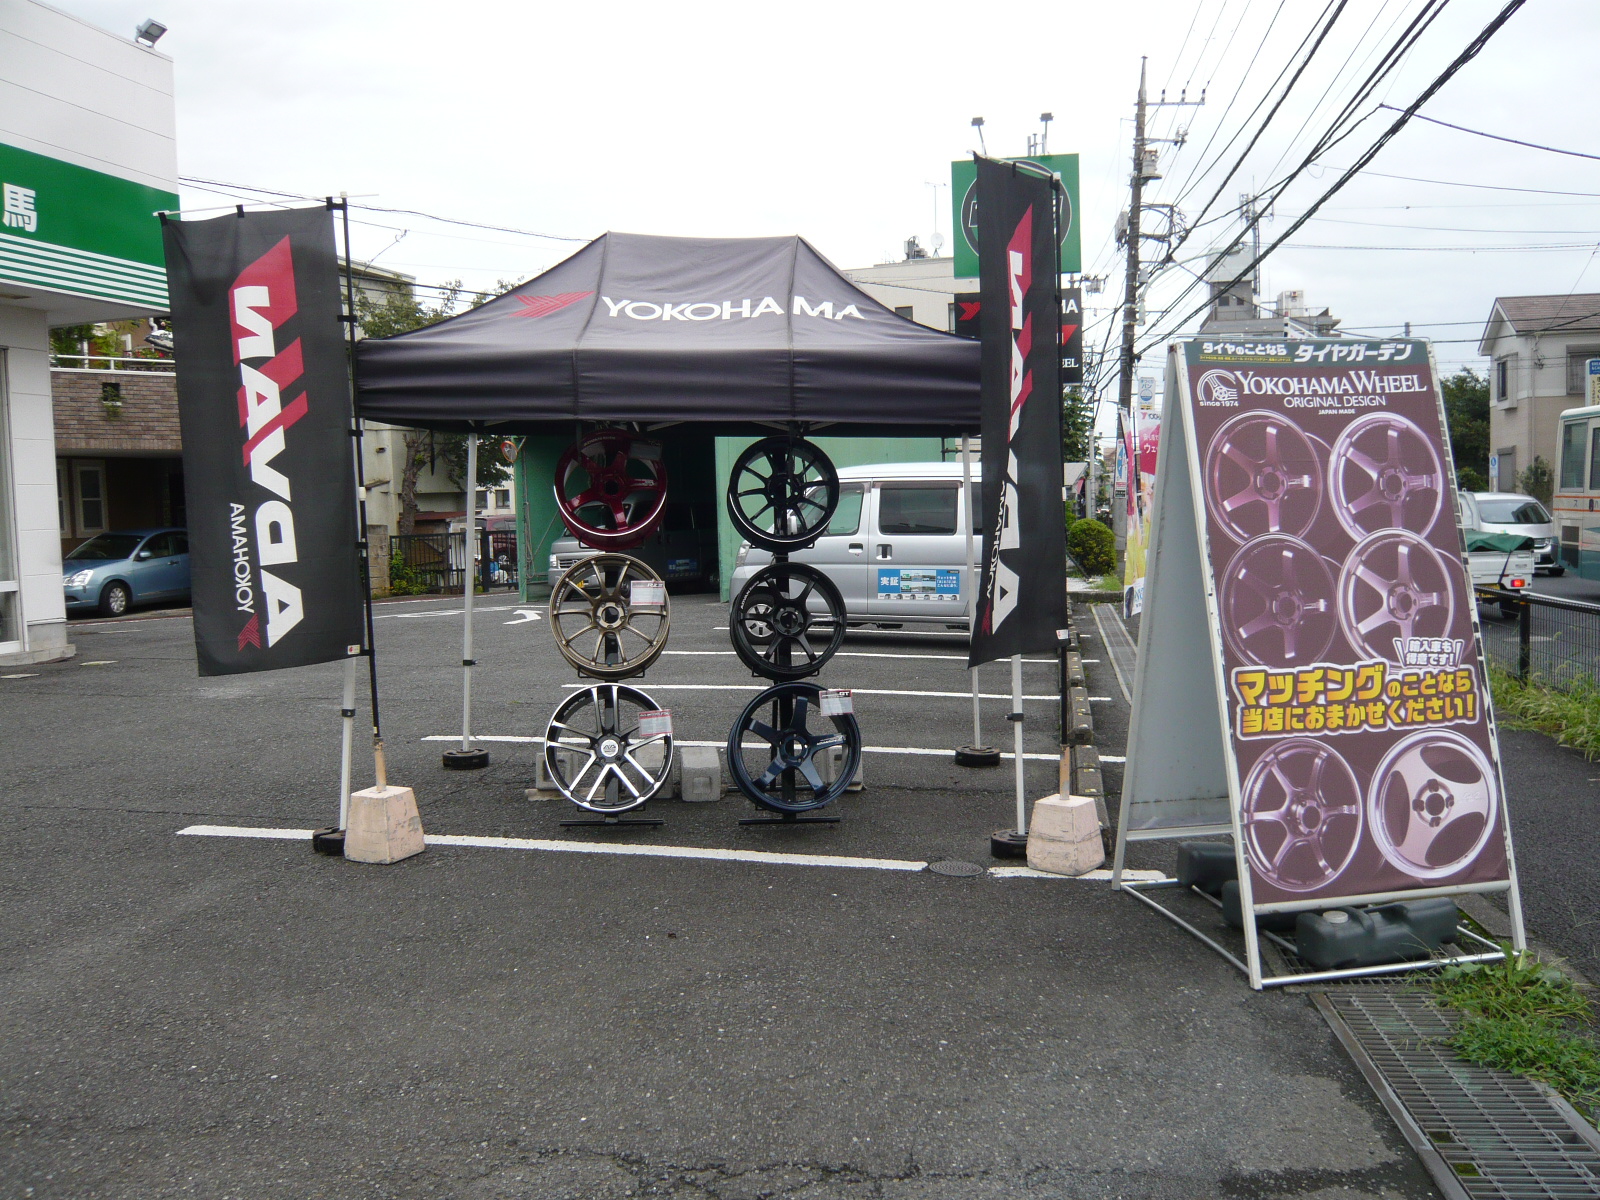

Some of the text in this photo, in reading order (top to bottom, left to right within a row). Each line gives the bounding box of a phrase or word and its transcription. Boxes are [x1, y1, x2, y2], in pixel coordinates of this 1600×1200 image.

[3, 183, 38, 232] 馬
[601, 296, 865, 321] YOKOHAMA
[1202, 342, 1287, 355] タイヤのことなら
[1293, 343, 1413, 363] タイヤガーデン
[1234, 370, 1427, 395] YOKOHAMA WHEEL
[1283, 395, 1386, 409] ORIGINAL DESIGN
[1237, 664, 1472, 705] マッチングのことなら
[1242, 694, 1475, 734] 当店におまかせください!
